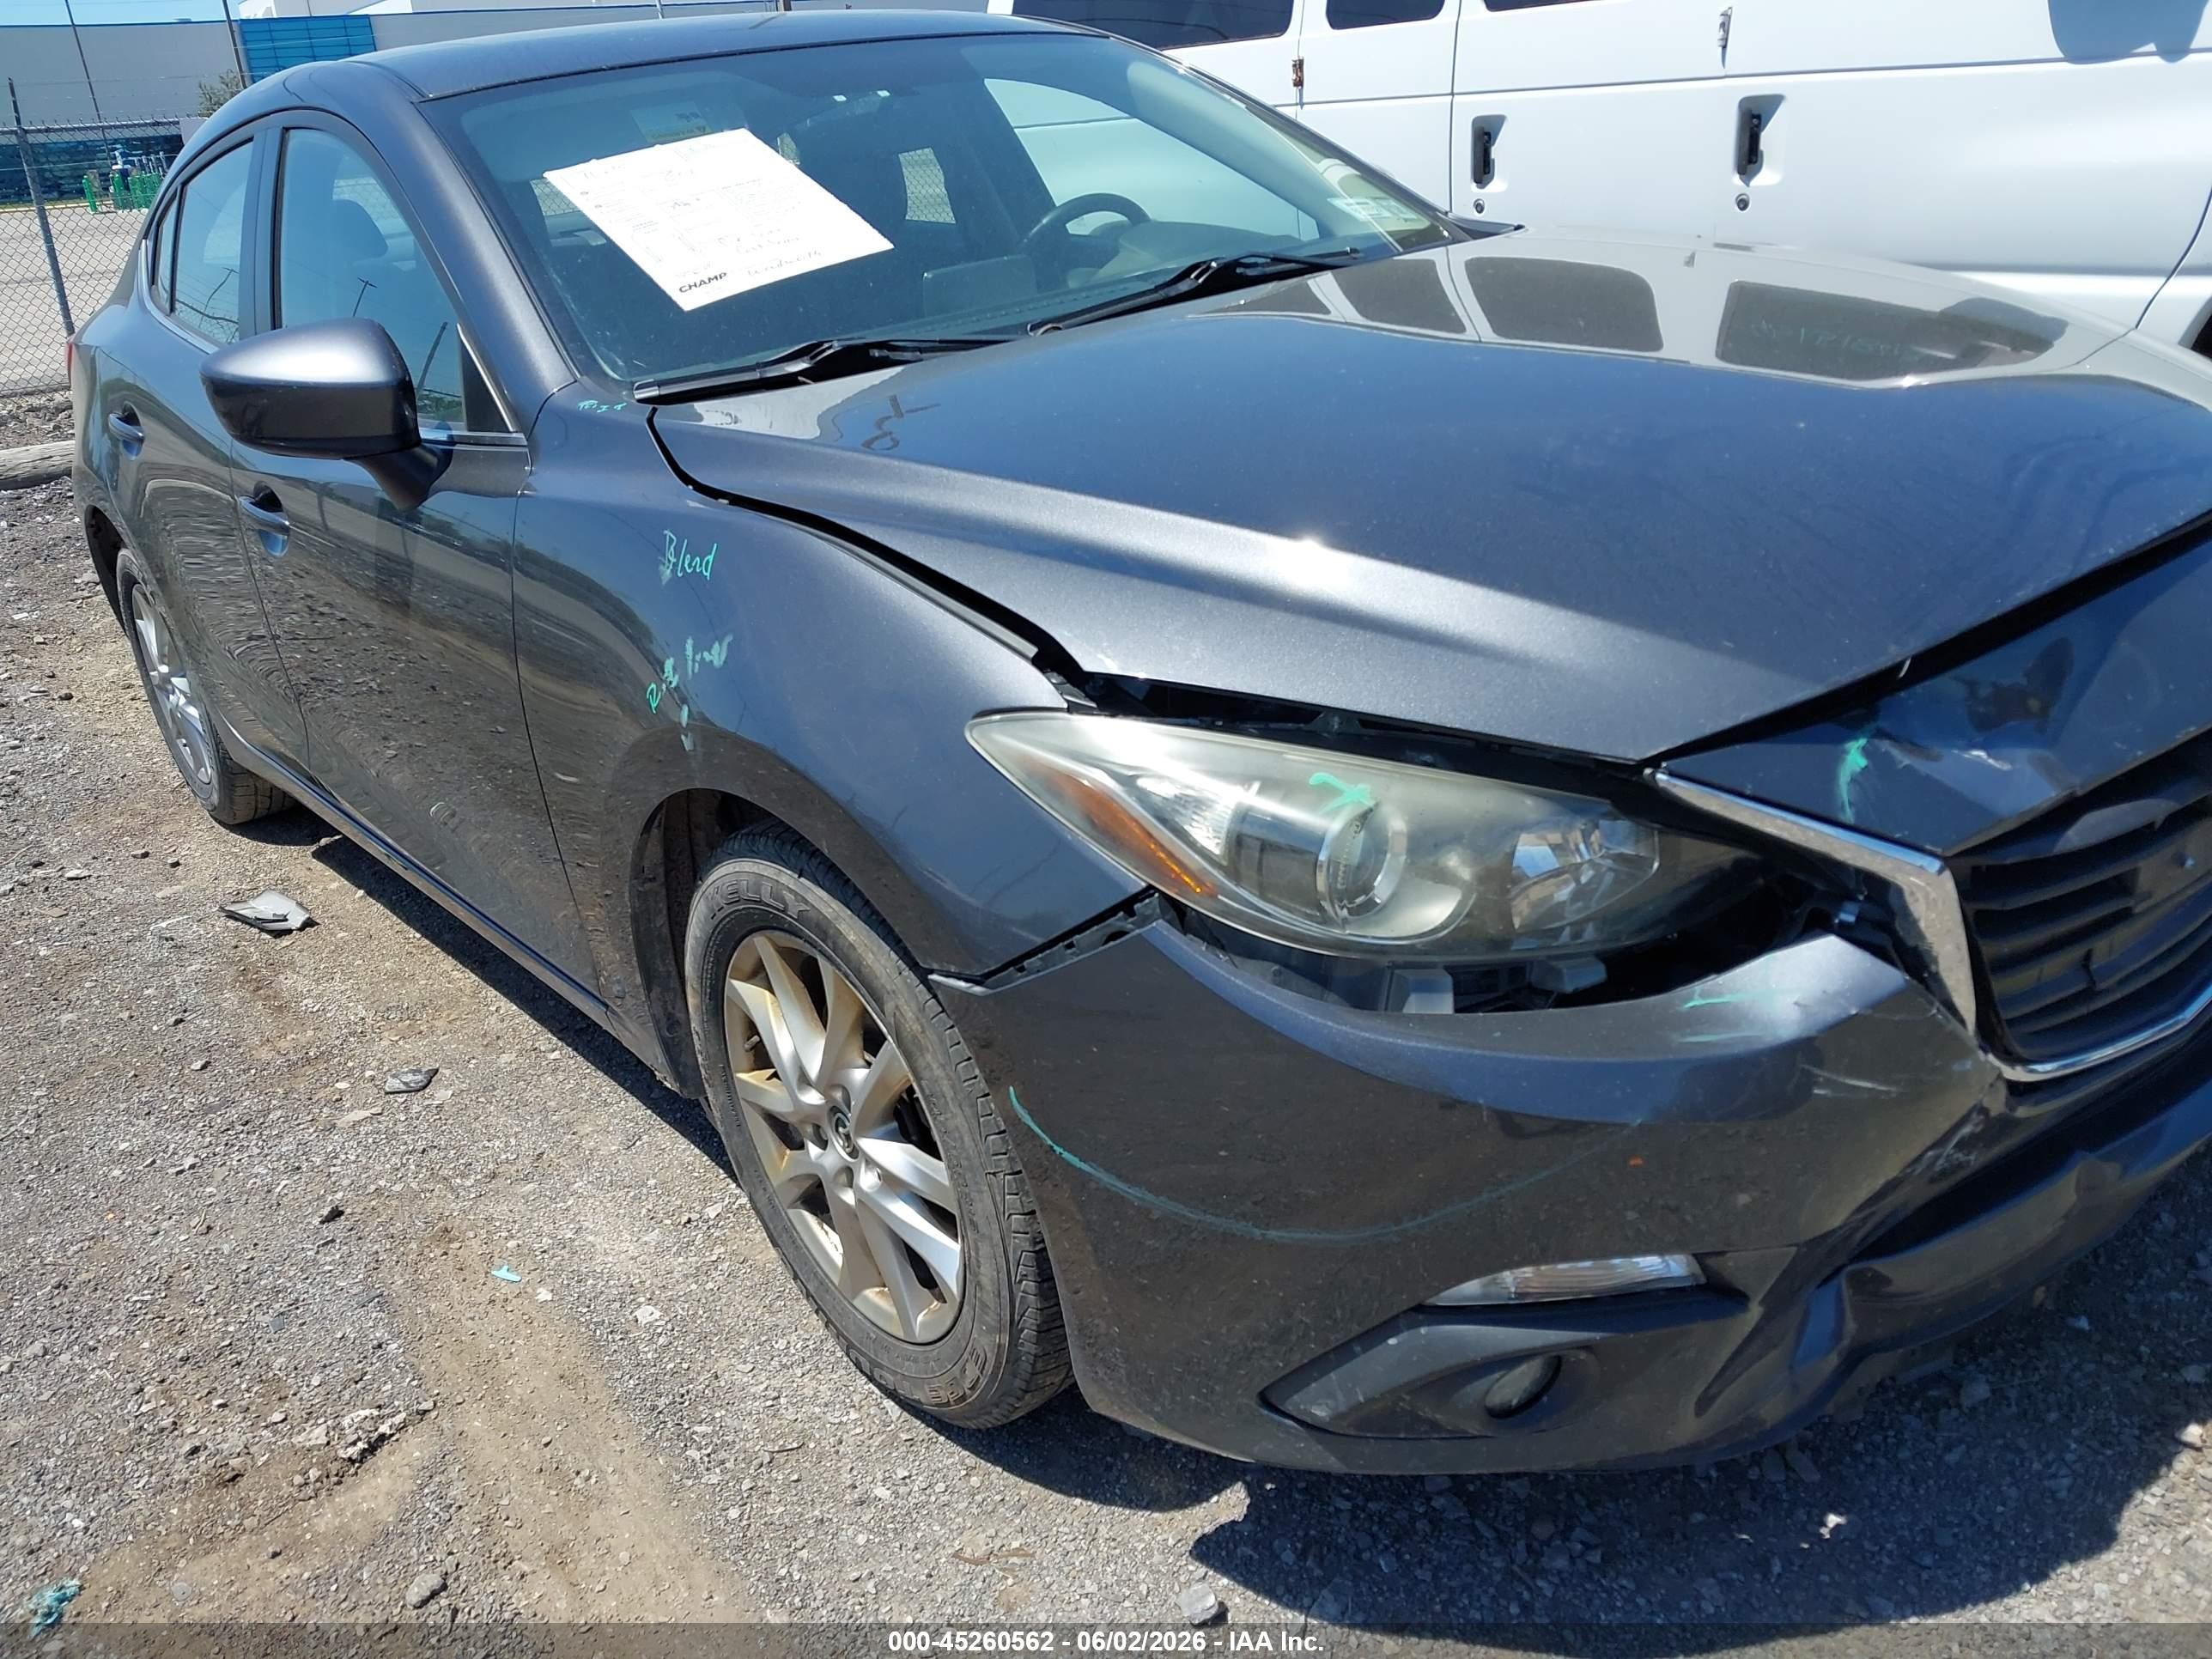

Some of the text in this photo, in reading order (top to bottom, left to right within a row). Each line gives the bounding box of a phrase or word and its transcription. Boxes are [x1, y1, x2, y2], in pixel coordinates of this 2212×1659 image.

[678, 271, 727, 294] CHAMP
[659, 529, 717, 581] Blend
[707, 878, 811, 920] KELLY
[925, 1343, 988, 1405] EDGE
